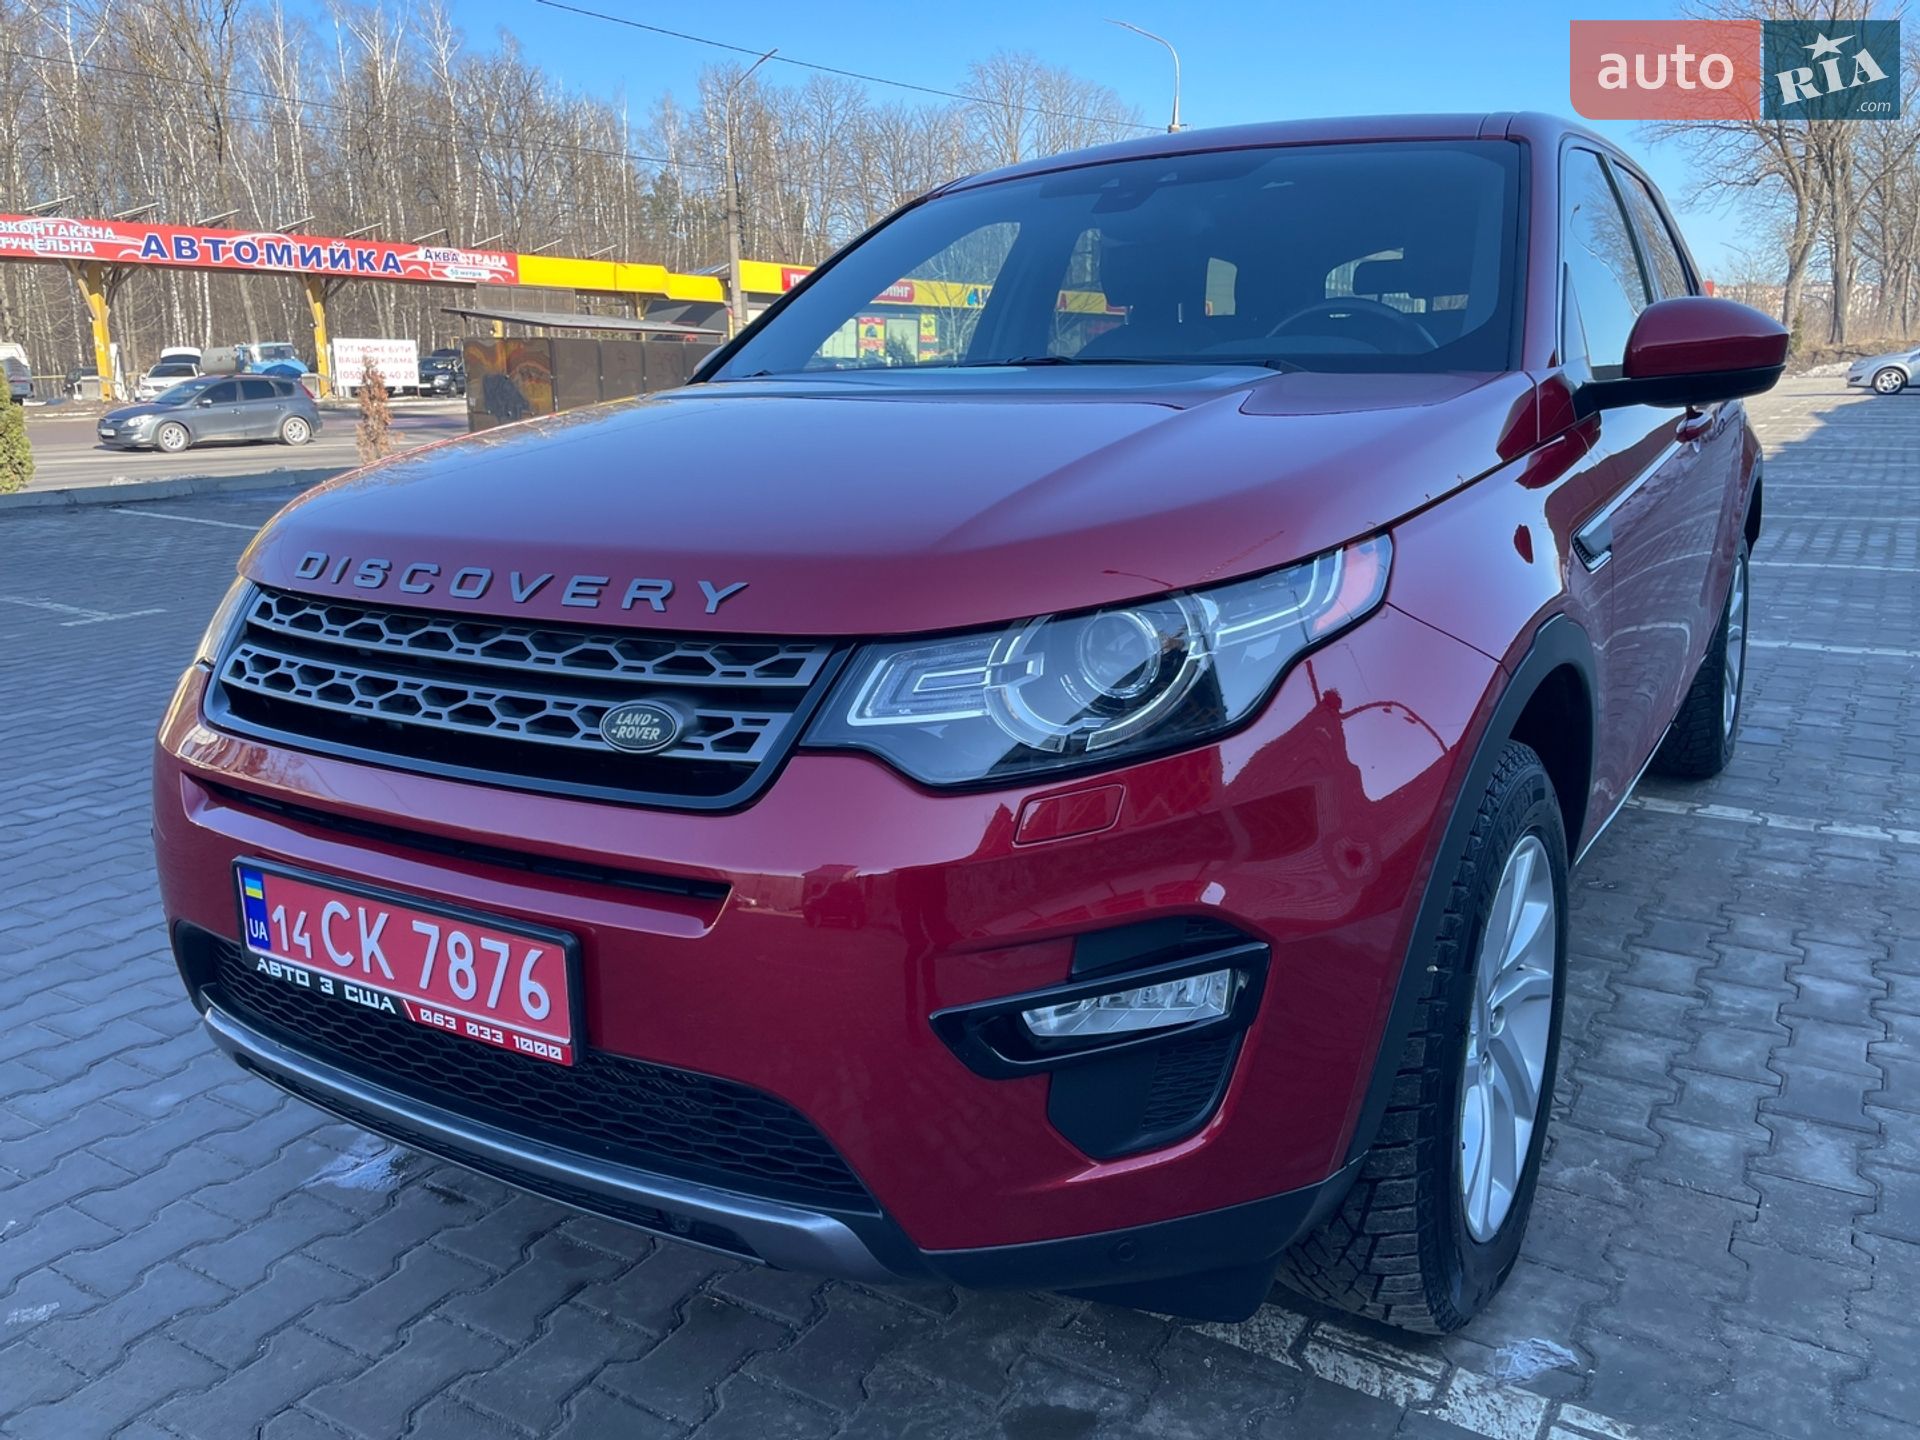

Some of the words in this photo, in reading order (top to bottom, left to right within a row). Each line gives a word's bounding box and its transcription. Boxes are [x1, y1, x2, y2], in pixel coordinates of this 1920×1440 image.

[140, 233, 405, 275] АВТОМИЙКА
[338, 345, 355, 353] ТУТ
[357, 345, 385, 353] МОЖЕ
[388, 345, 412, 353] БУТИ
[388, 371, 401, 380] 40
[403, 371, 416, 380] 20
[294, 551, 749, 614] DISCOVERY
[616, 712, 652, 726] LAND
[616, 726, 661, 741] ROVER
[249, 918, 268, 942] UA
[412, 919, 551, 1021] 7876
[257, 957, 311, 988] АВТО
[344, 984, 397, 1015] США
[419, 1007, 457, 1031] 063
[466, 1021, 504, 1044] 033
[513, 1034, 563, 1061] 1000
